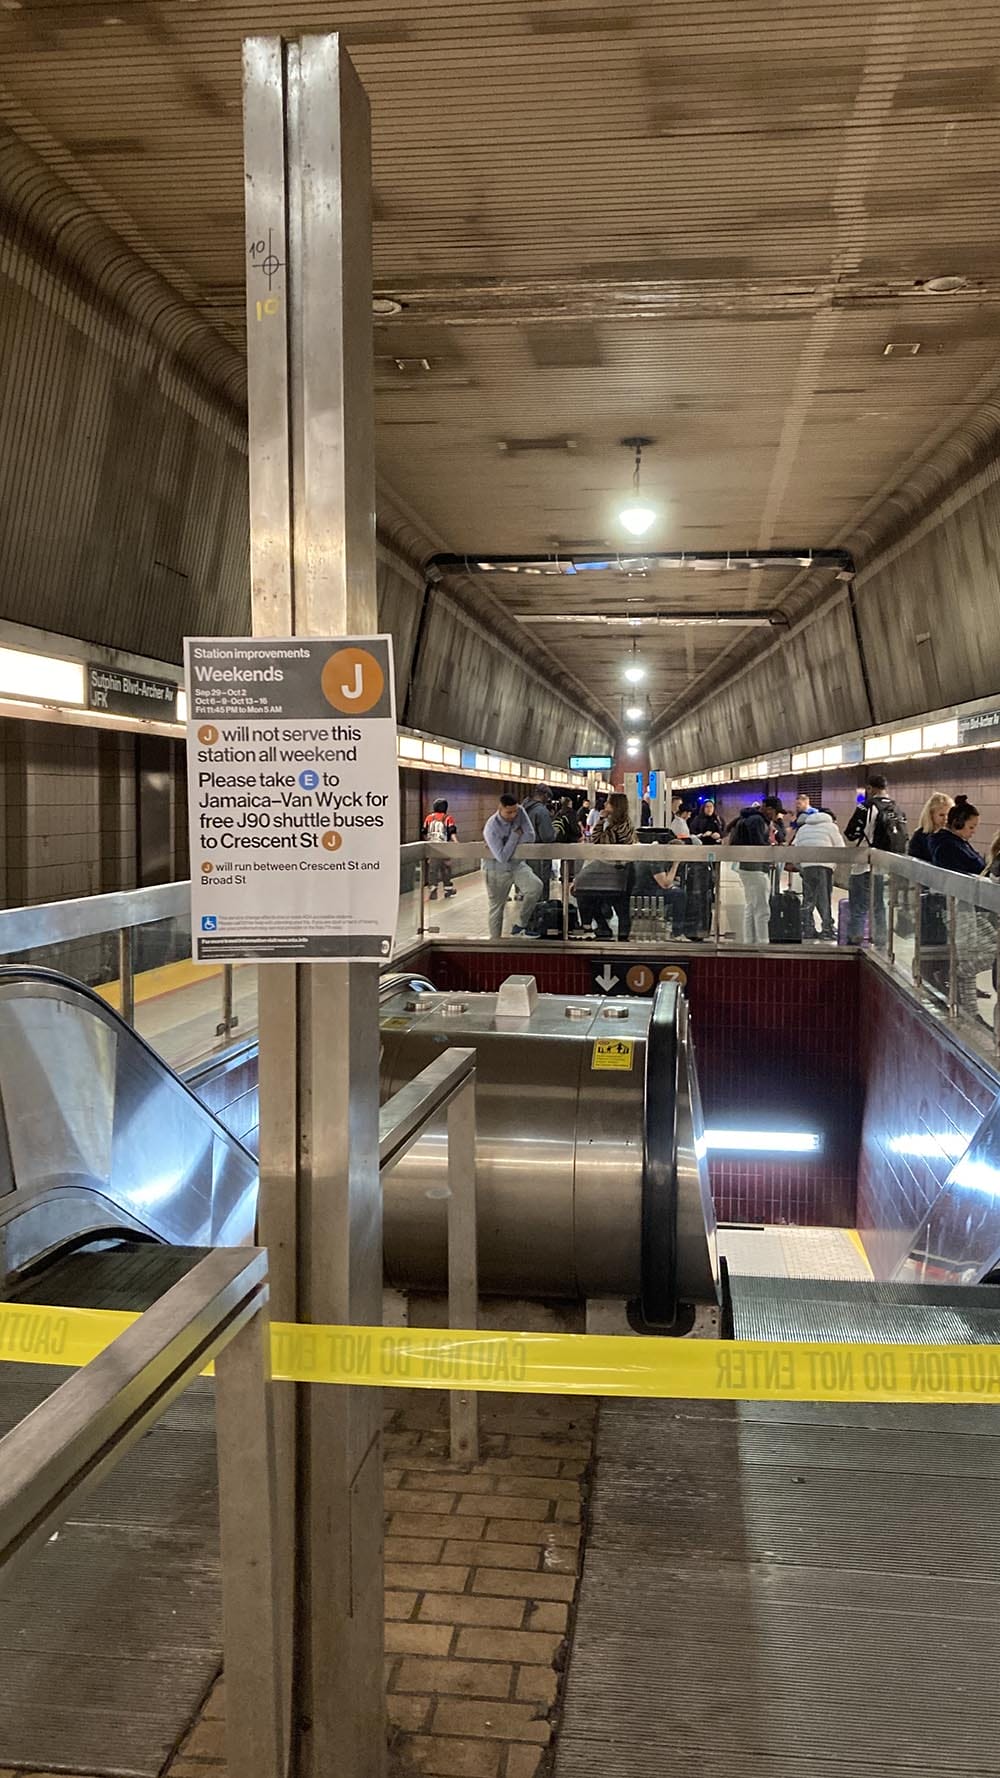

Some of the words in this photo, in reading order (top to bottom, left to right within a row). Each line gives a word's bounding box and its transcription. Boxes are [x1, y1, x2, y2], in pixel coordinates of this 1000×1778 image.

[249, 240, 265, 259] 10
[194, 647, 233, 660] Station
[234, 647, 311, 660] improvements
[194, 665, 284, 682] Weekends
[341, 663, 363, 699] J
[91, 670, 121, 692] Sutphin
[164, 687, 174, 701] Av
[91, 690, 108, 708] JFK
[222, 726, 249, 742] will
[252, 728, 280, 742] not
[282, 729, 329, 742] serve
[332, 725, 362, 741] this
[198, 747, 256, 763] station
[259, 746, 276, 762] all
[280, 746, 357, 762] weekend
[199, 772, 256, 788] Please
[260, 772, 296, 788] take
[323, 772, 340, 787] to
[315, 791, 363, 810] Wyck
[366, 791, 389, 807] for
[199, 813, 234, 829] free
[237, 813, 270, 828] J90
[273, 812, 331, 828] shuttle
[333, 812, 384, 828] buses
[200, 834, 217, 849] to
[221, 833, 298, 849] Crescent
[300, 833, 319, 848] St
[216, 862, 233, 871] will
[235, 863, 251, 871] run
[254, 861, 298, 871] between
[299, 861, 346, 871] Crescent
[348, 860, 360, 870] St
[361, 860, 380, 870] and
[201, 875, 233, 886] Broad
[235, 875, 246, 884] St
